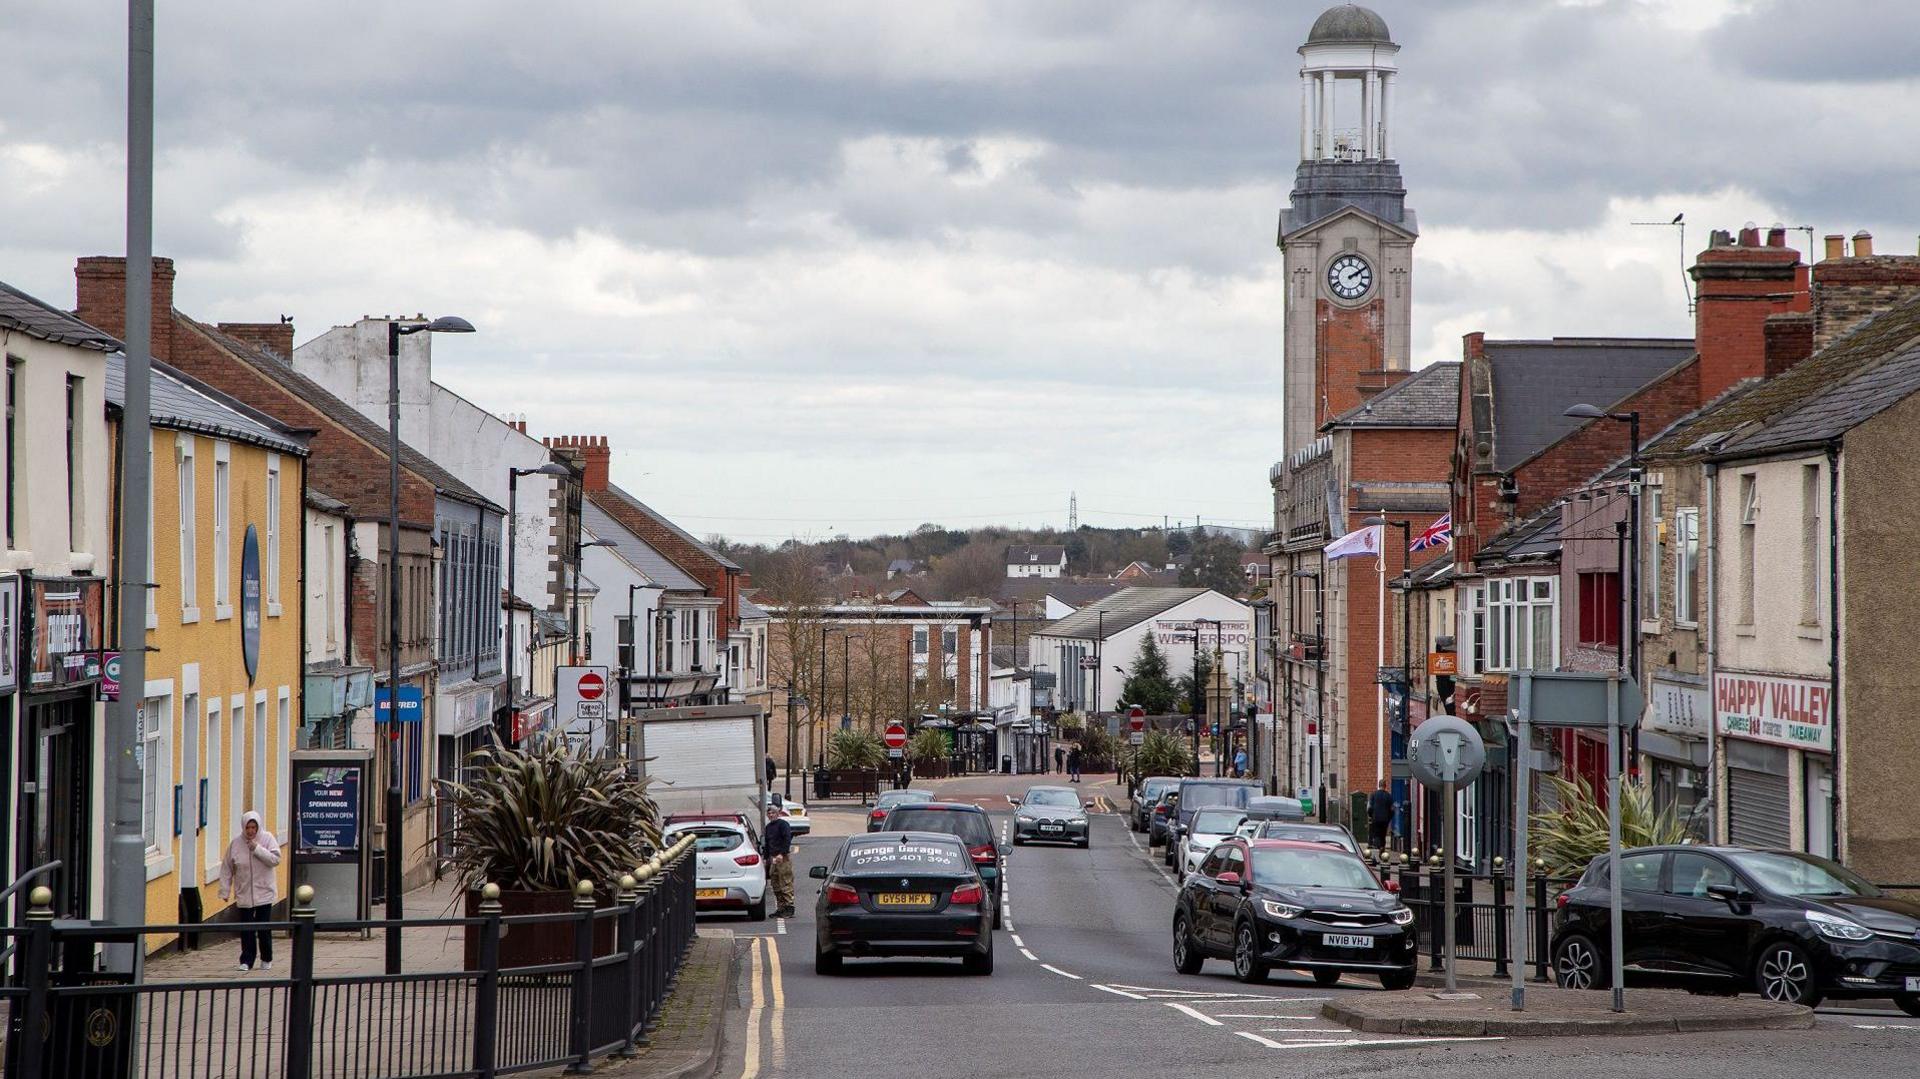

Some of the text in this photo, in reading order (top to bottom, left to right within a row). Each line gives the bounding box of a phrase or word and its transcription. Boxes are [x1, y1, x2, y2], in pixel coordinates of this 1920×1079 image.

[1157, 622, 1174, 630] THE
[1206, 622, 1245, 630] ELCTRIC
[380, 701, 418, 709] BEFRED
[1718, 677, 1767, 717] HAPPY
[1771, 682, 1831, 725] VALLEY
[1788, 725, 1823, 743] TAKEAWAY
[850, 845, 895, 858] Grange
[898, 845, 942, 855] Garage
[857, 855, 896, 865] 07368
[927, 856, 951, 865] 396
[882, 893, 927, 903] GY58 MFX
[1328, 935, 1370, 946] NV18 VHJ
